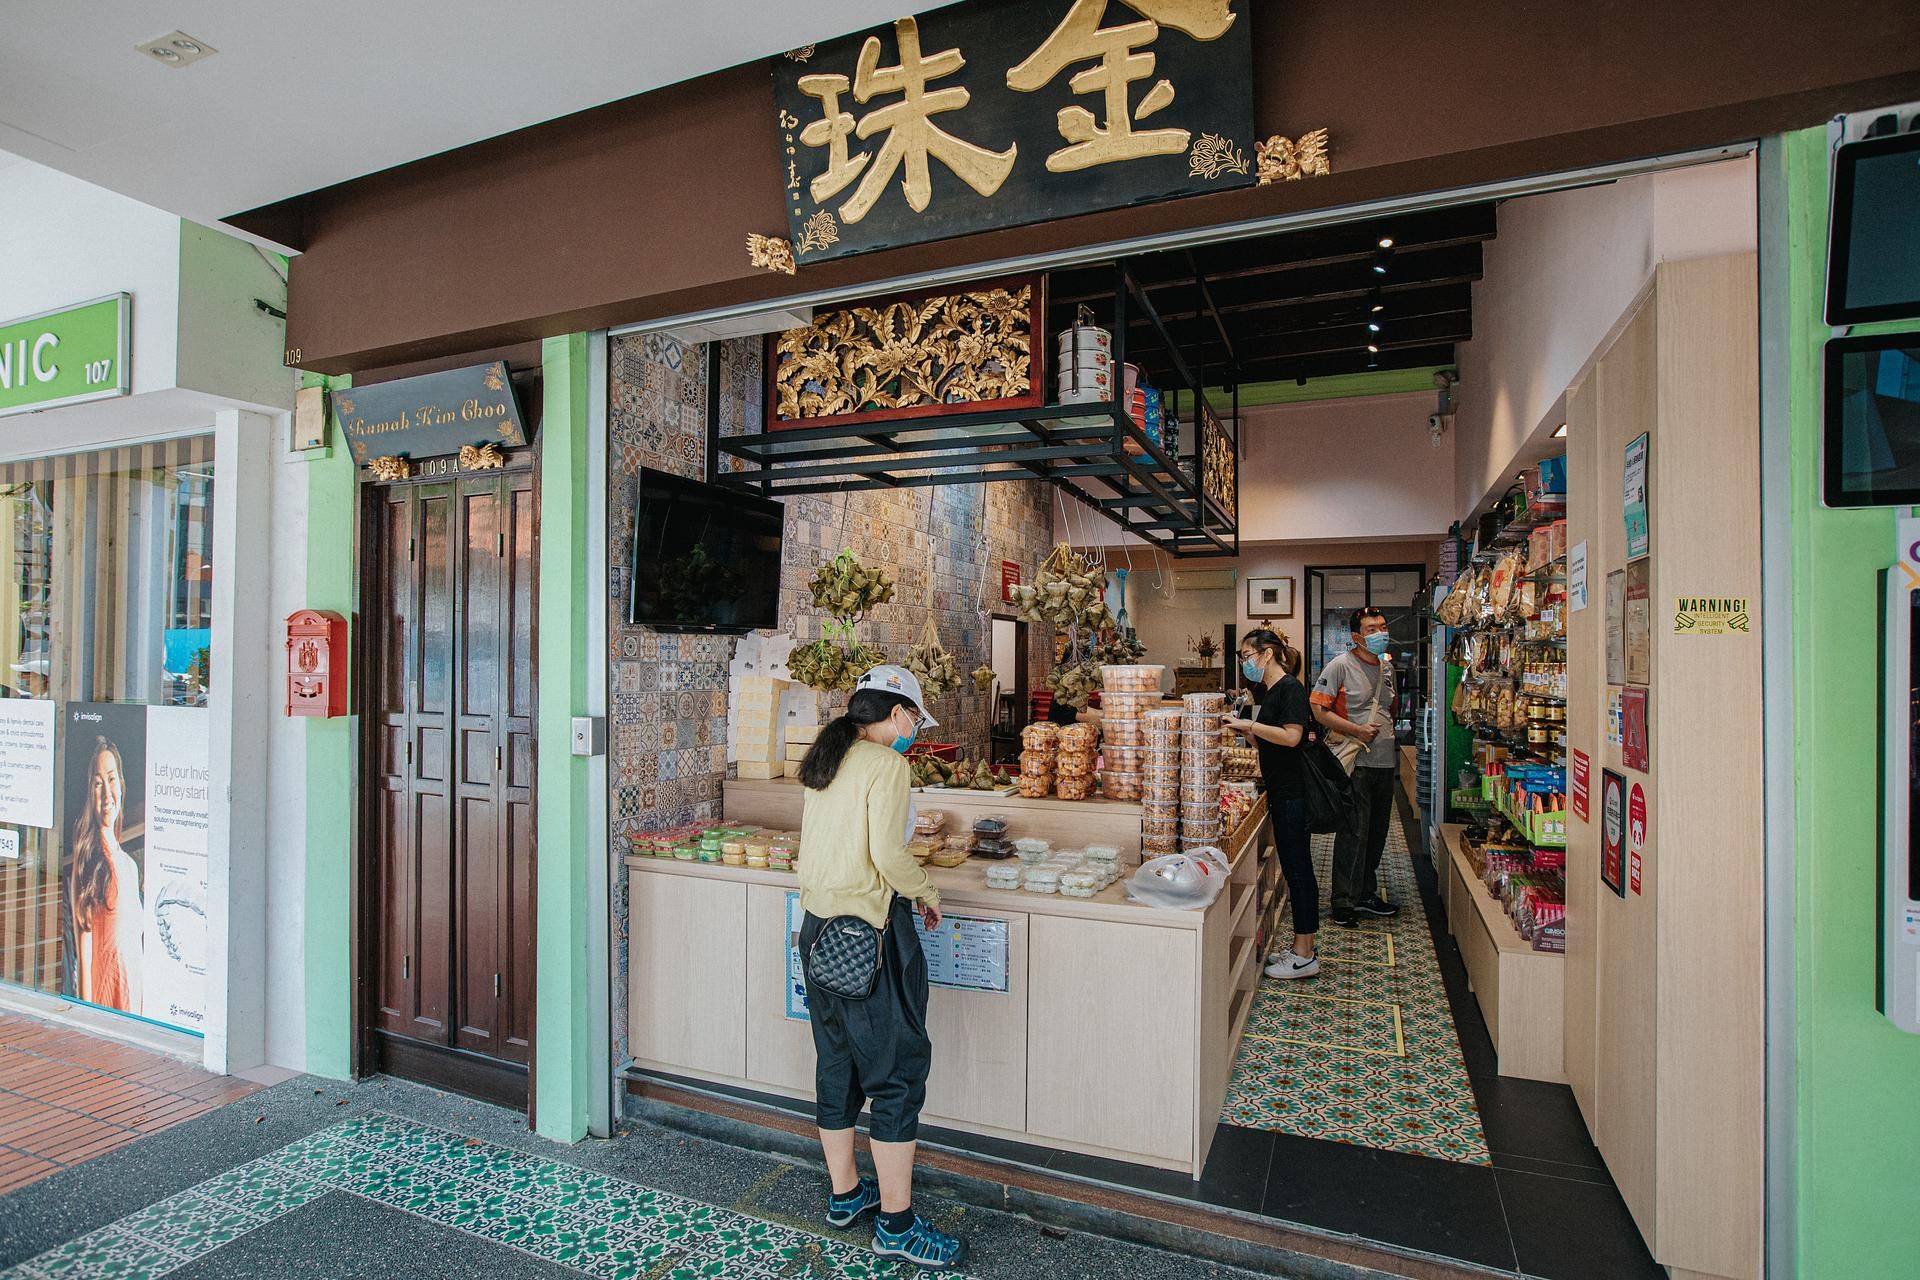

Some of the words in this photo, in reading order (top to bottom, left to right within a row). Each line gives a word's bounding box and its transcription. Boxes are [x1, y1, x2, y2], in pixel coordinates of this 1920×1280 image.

[285, 348, 302, 366] 109
[85, 359, 113, 385] 107
[349, 411, 410, 437] Rumah
[415, 405, 456, 428] Kim
[462, 399, 506, 420] Choo
[1678, 598, 1746, 613] WARNING!
[80, 712, 103, 722] invisalign
[154, 762, 168, 777] Let
[169, 767, 189, 780] your
[154, 781, 186, 800] journey
[186, 786, 206, 800] start
[178, 1006, 204, 1021] invisalign
